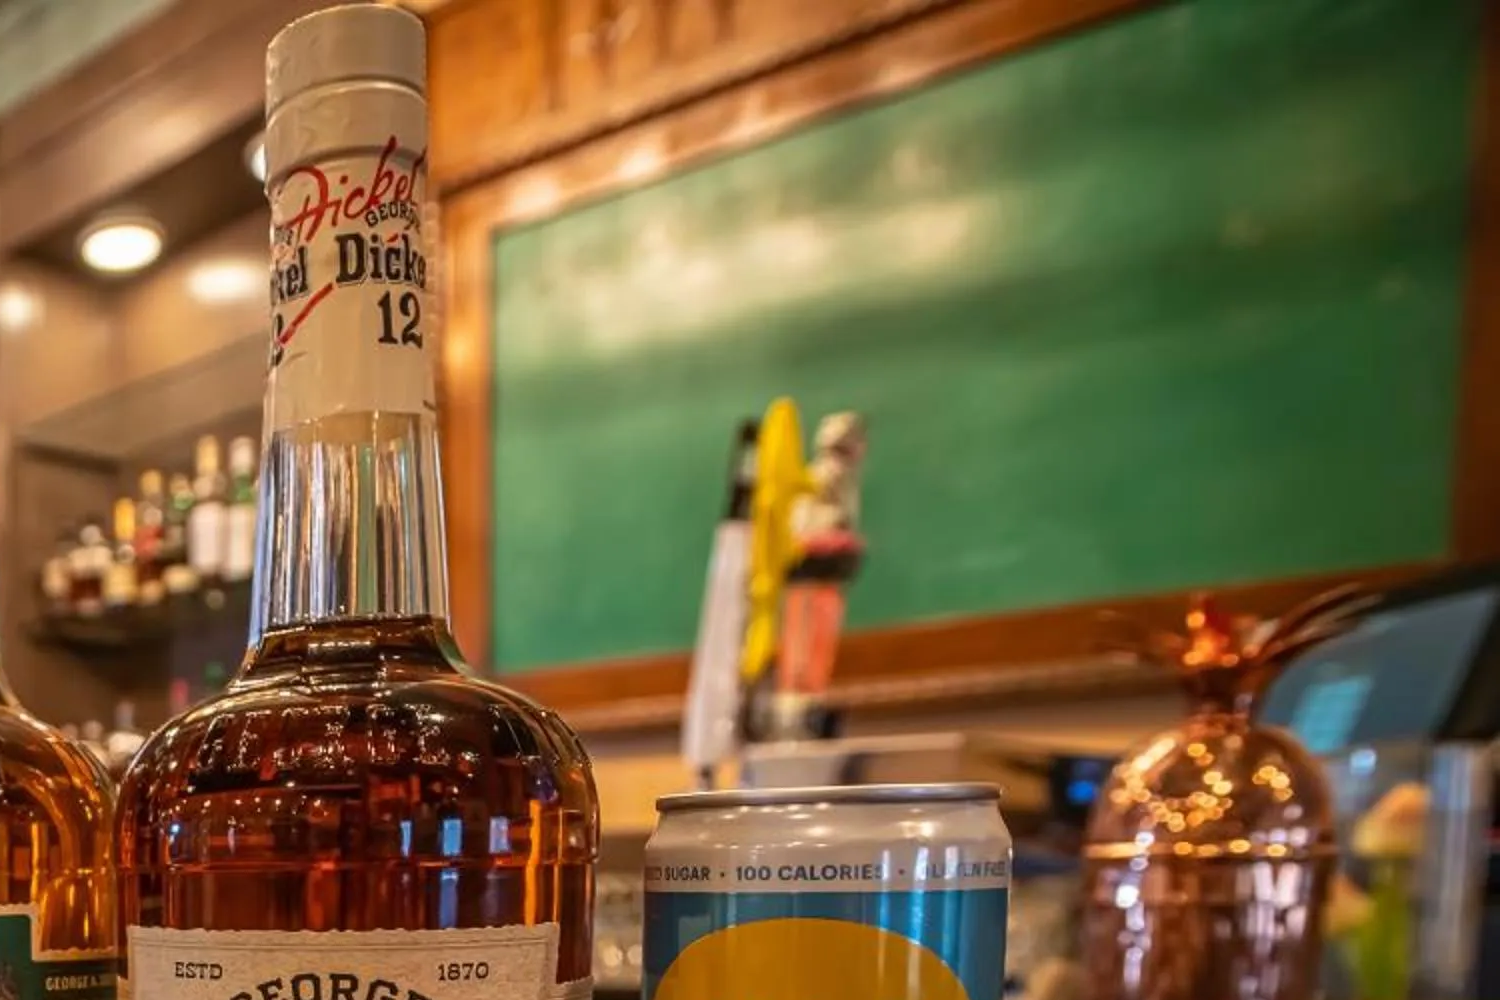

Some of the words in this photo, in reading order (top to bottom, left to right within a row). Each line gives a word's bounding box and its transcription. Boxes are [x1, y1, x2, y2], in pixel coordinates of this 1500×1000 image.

[336, 232, 426, 288] Dicke
[378, 290, 423, 349] 12
[665, 866, 711, 881] SUGAR
[736, 866, 771, 880] 100
[778, 864, 884, 880] CALORIES
[175, 962, 223, 979] ESTD
[437, 962, 490, 981] 1870
